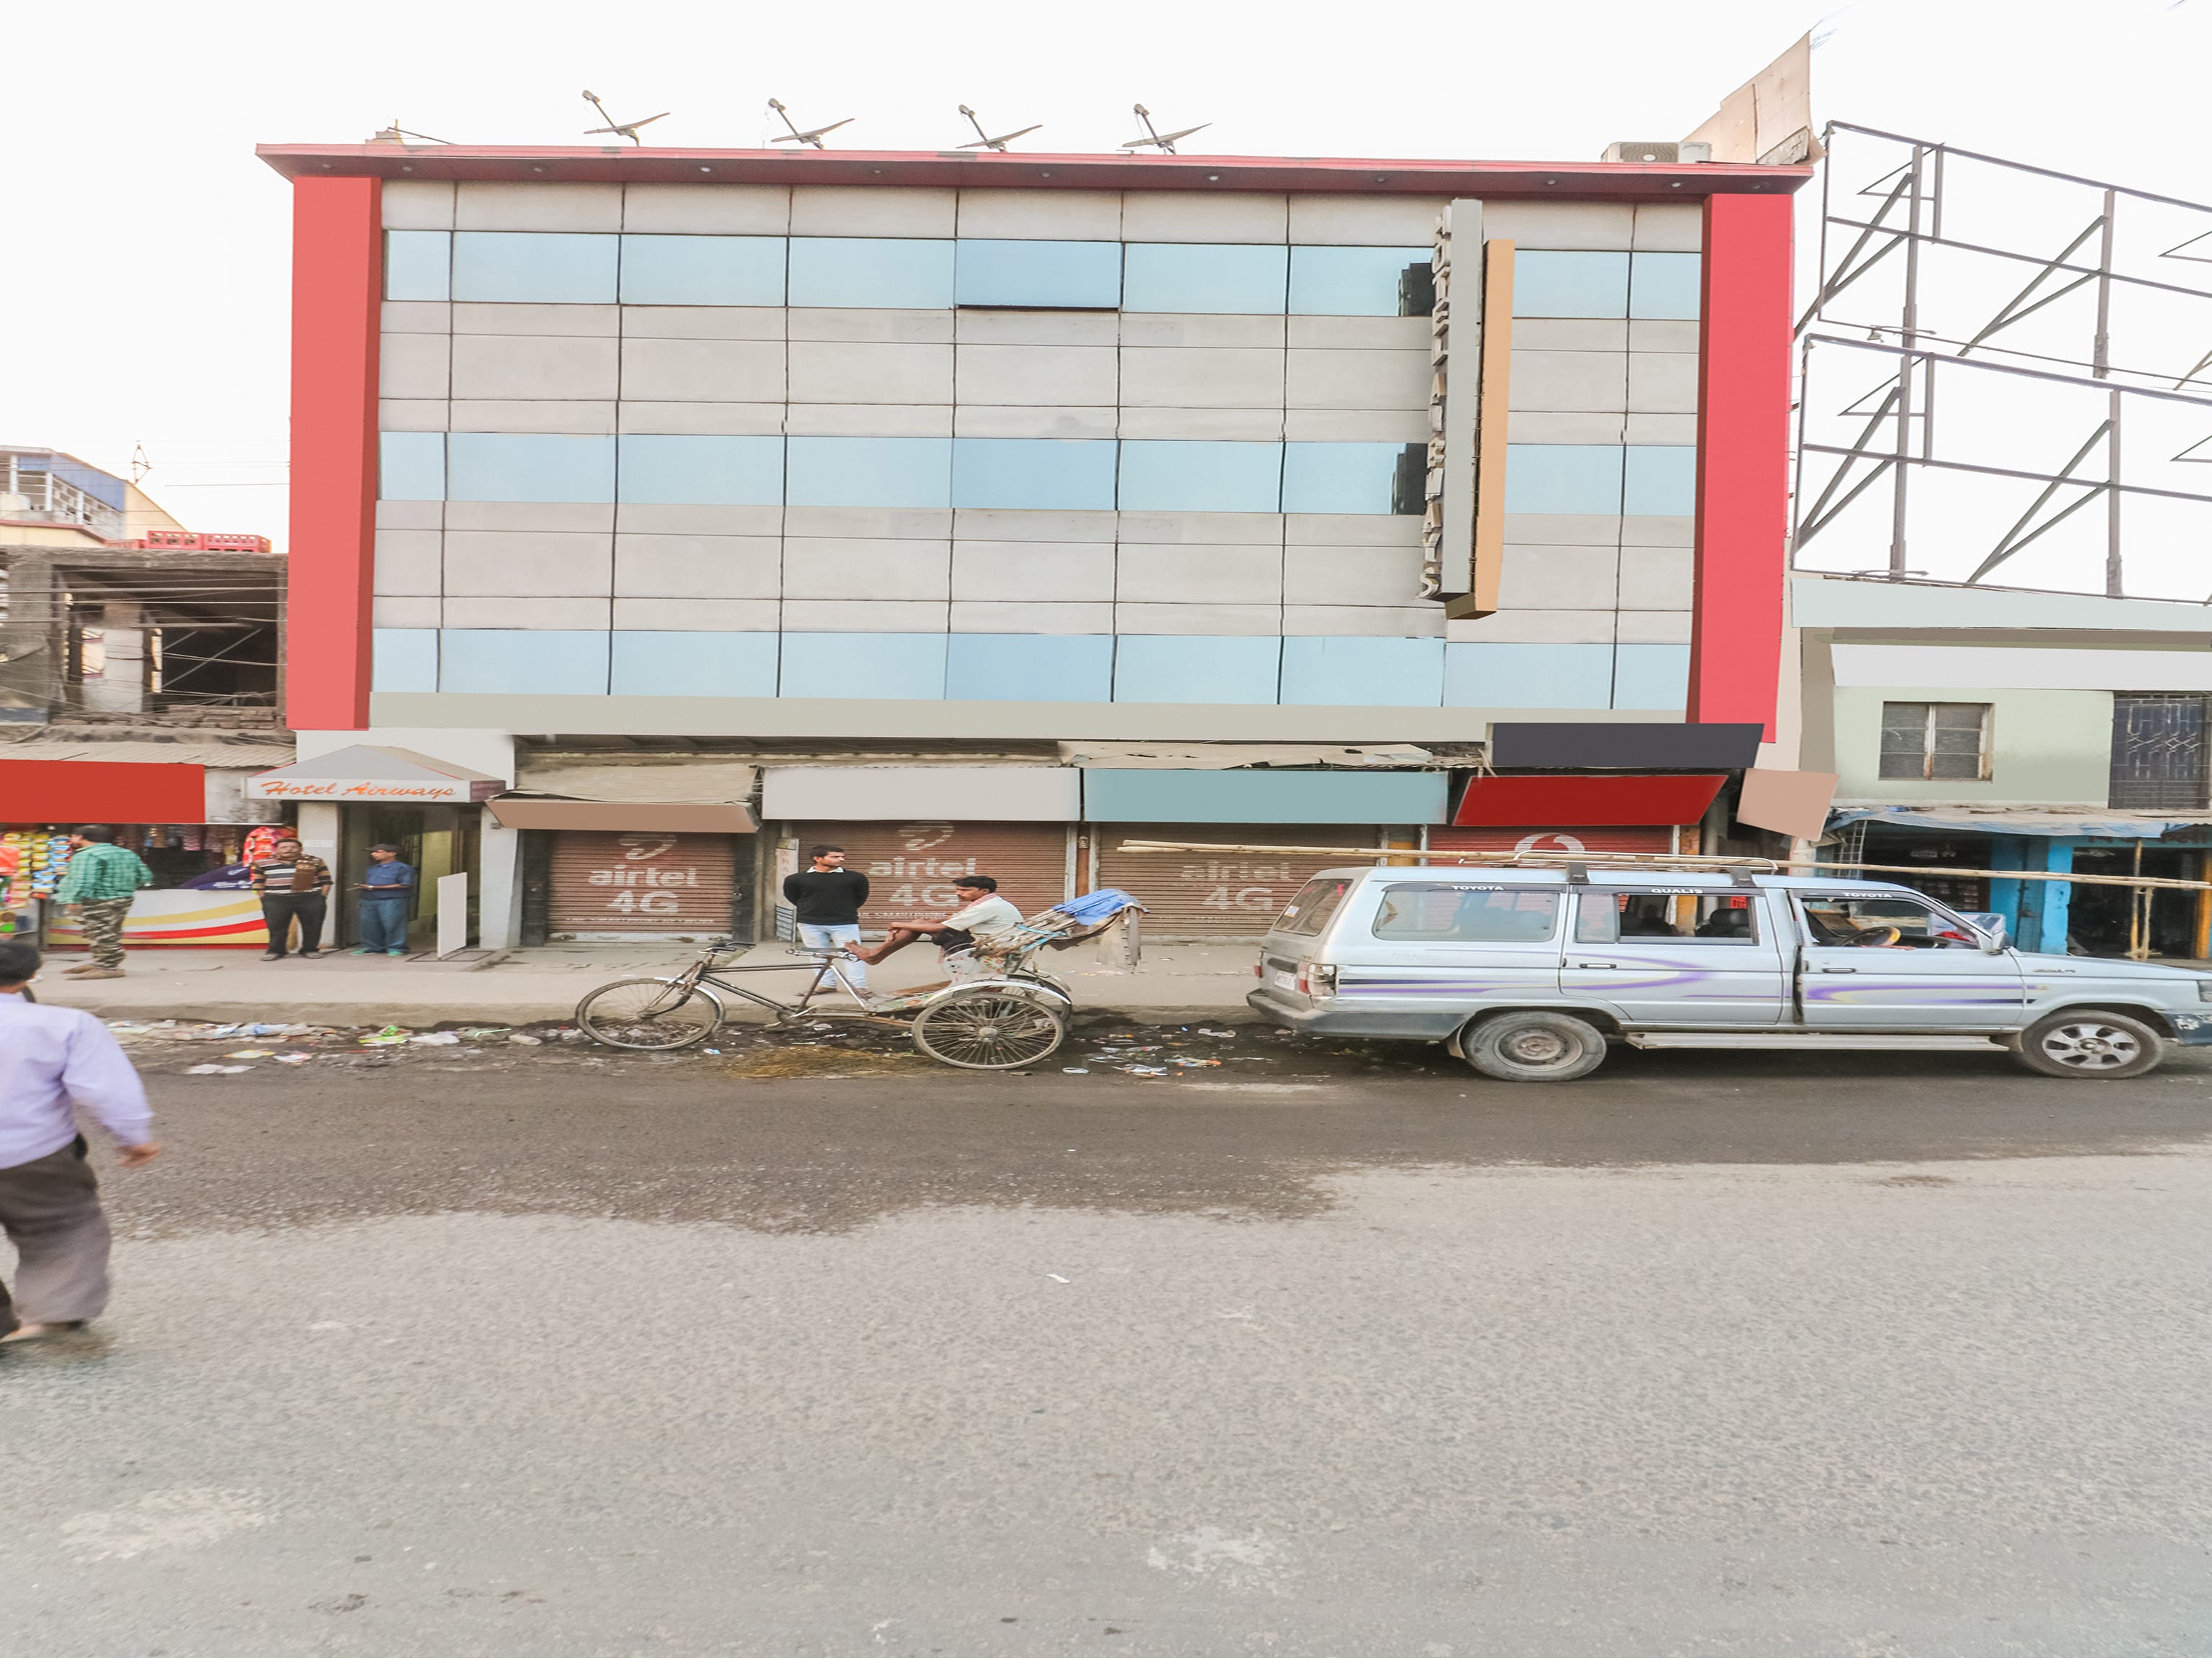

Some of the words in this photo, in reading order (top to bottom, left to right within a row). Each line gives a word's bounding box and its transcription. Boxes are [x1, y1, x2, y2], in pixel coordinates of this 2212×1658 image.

[1431, 204, 1452, 366] HOTEL
[260, 781, 337, 796] Hotel
[340, 779, 456, 799] Airways
[588, 864, 699, 887] airtel
[868, 856, 977, 879] airtel
[606, 890, 680, 913] 4G
[889, 884, 959, 907] 4G
[1202, 887, 1273, 910] 4G
